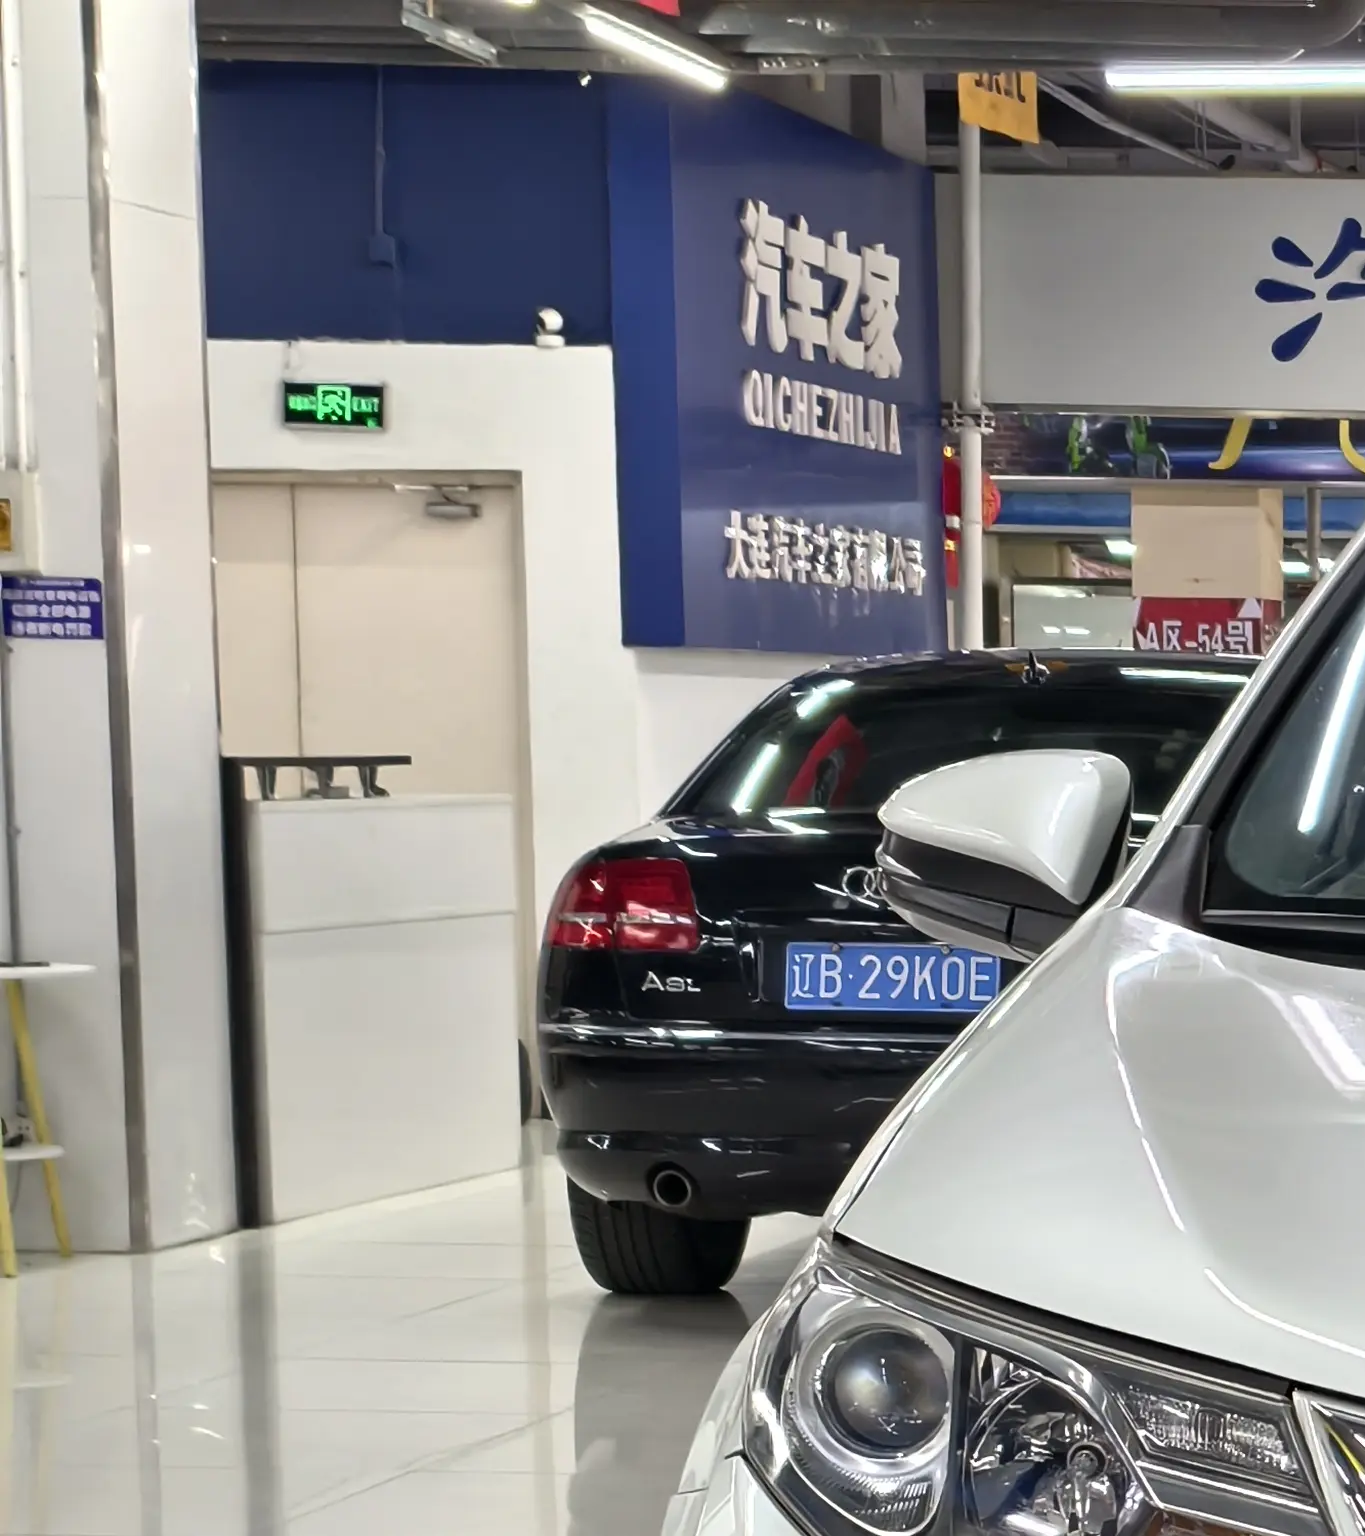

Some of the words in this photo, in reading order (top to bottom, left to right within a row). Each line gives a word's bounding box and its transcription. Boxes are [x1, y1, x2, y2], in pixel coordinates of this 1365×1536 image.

[740, 199, 902, 379] 汽车之家
[742, 369, 902, 455] QICHEZHIJIA
[641, 970, 701, 992] A8L
